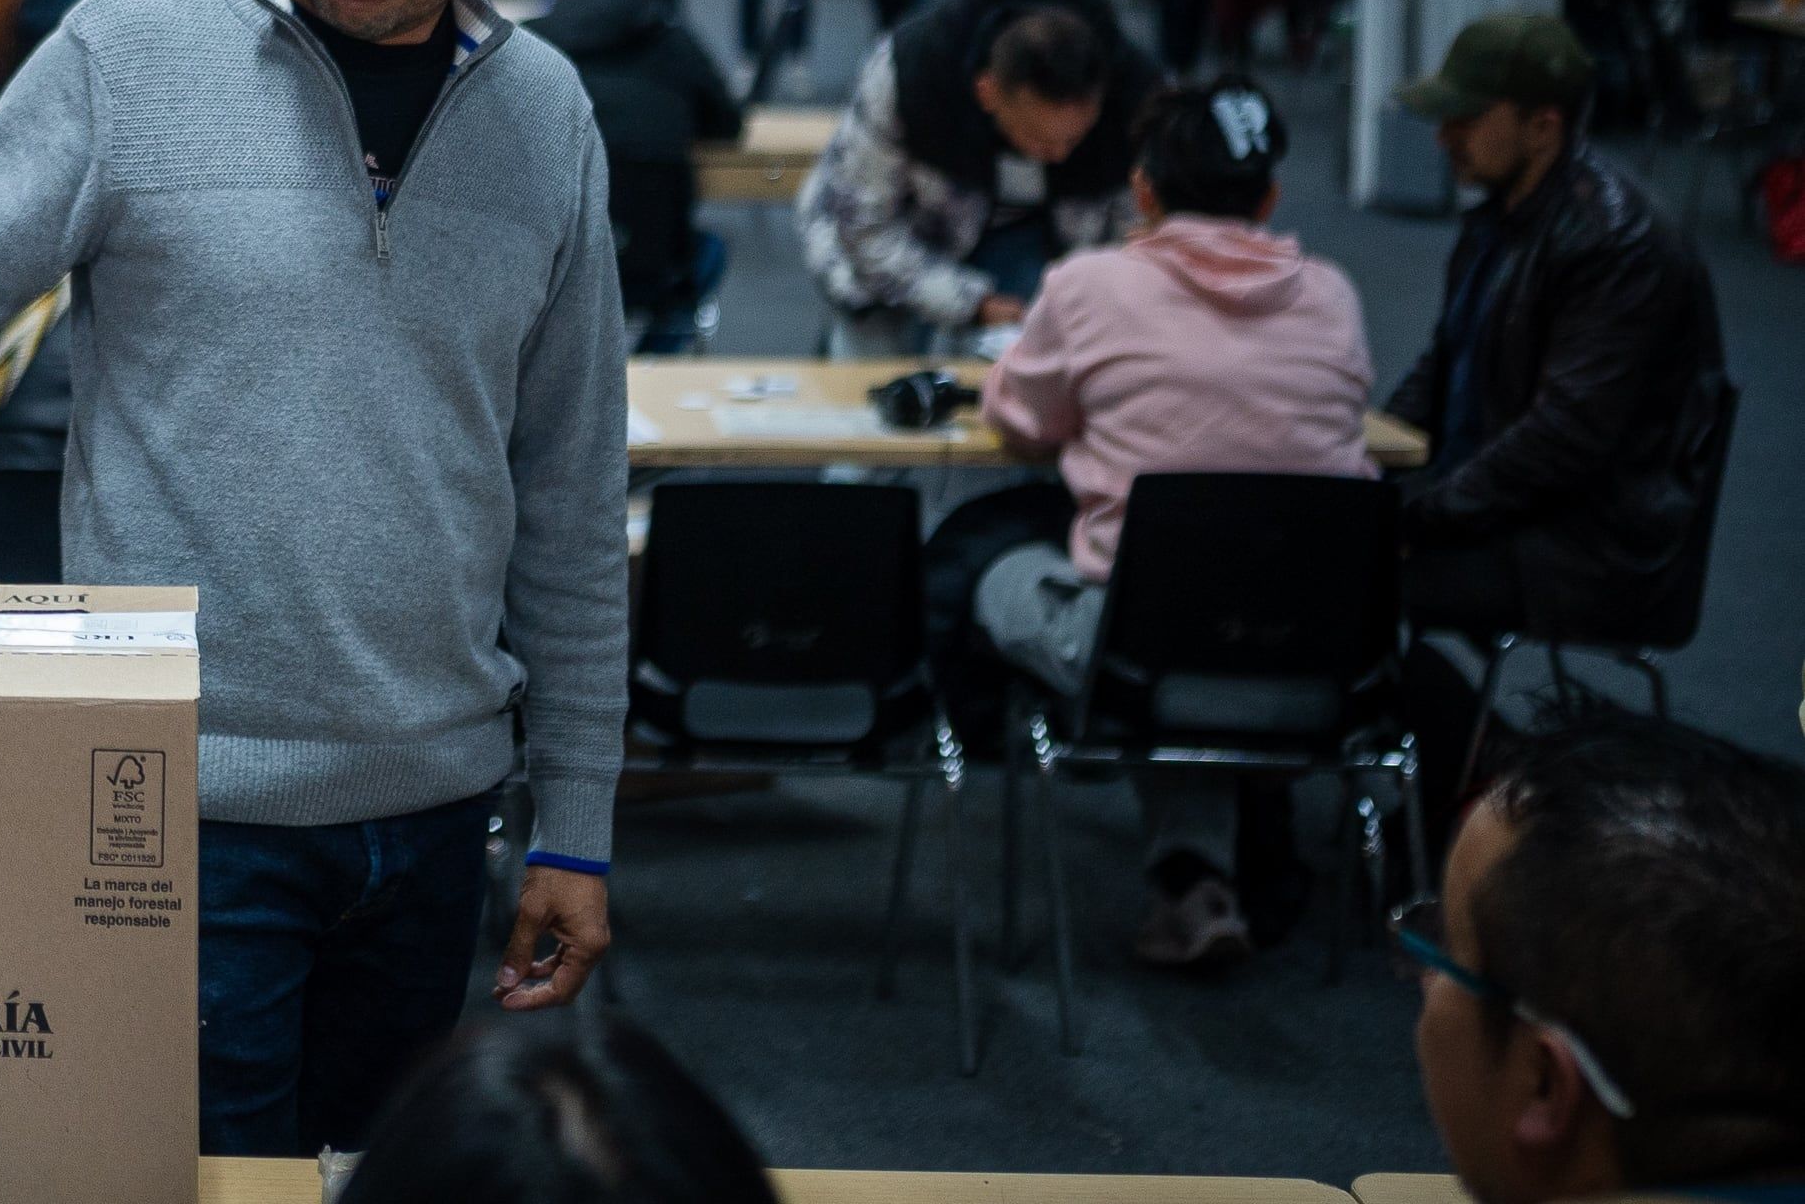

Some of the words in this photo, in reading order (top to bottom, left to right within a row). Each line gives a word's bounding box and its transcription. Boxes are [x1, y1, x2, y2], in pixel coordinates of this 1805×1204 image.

[112, 790, 145, 802] FSC
[114, 814, 142, 824] MIXTO
[84, 877, 100, 890] La
[104, 879, 147, 892] marca
[151, 879, 173, 892] del
[74, 896, 125, 911] manejo
[129, 897, 182, 911] forestal
[84, 913, 171, 929] responsable
